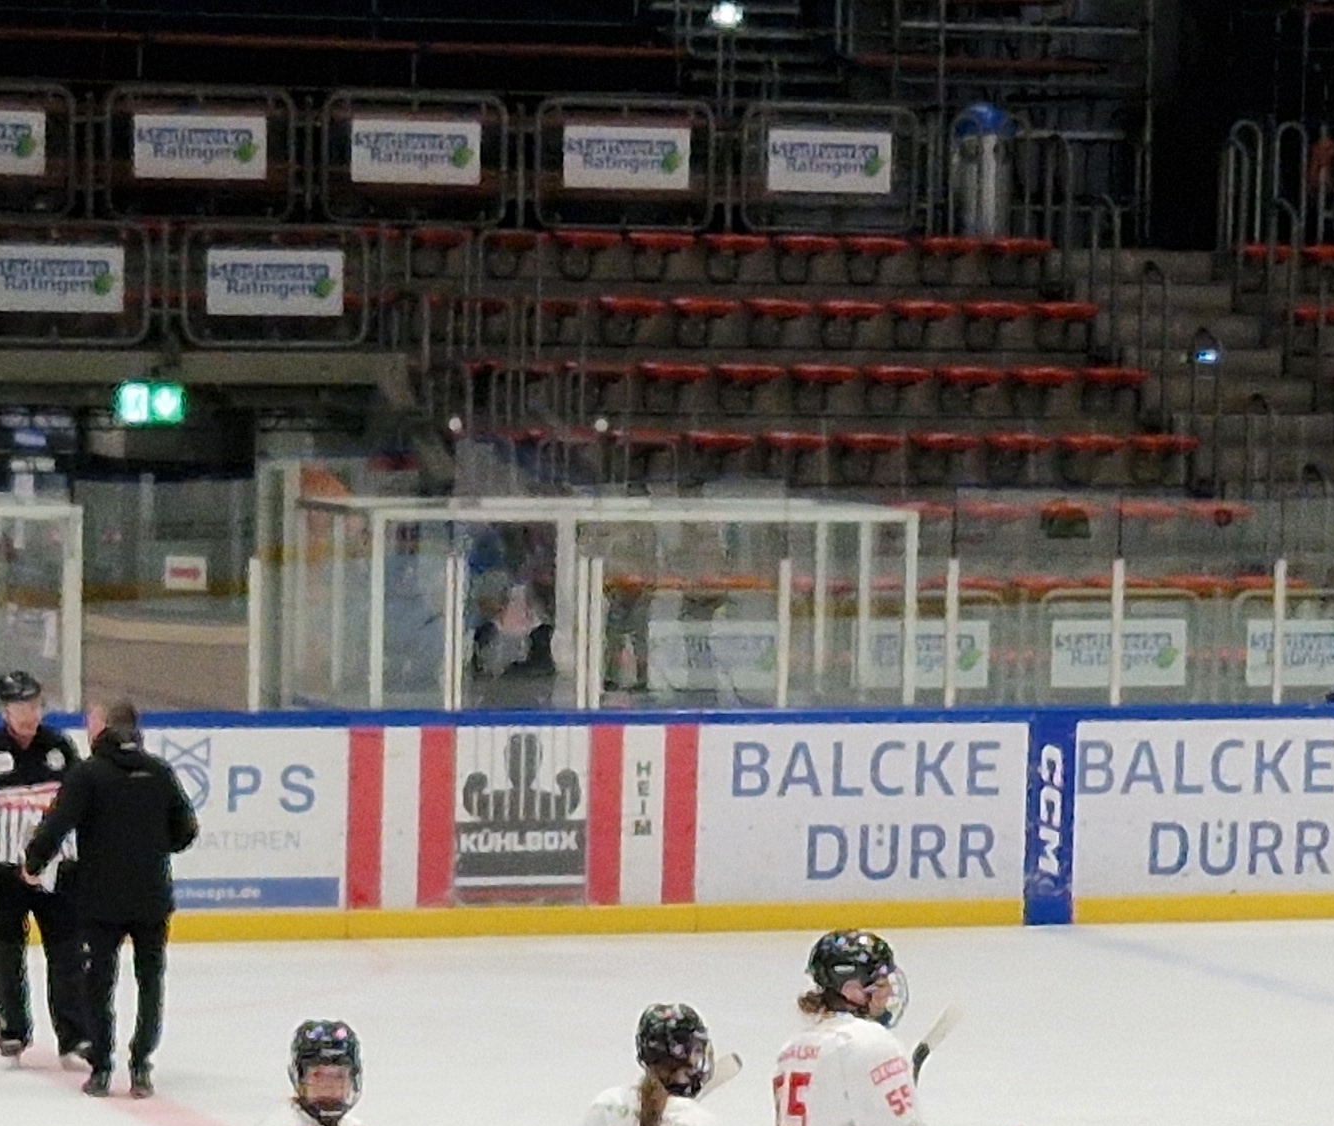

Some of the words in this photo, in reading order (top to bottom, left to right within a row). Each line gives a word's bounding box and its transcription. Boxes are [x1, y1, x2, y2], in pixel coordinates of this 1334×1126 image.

[731, 740, 1001, 798] BALCKE
[1037, 744, 1065, 877] CCM
[805, 822, 996, 882] DÜRR
[1148, 818, 1333, 877] DÜRR
